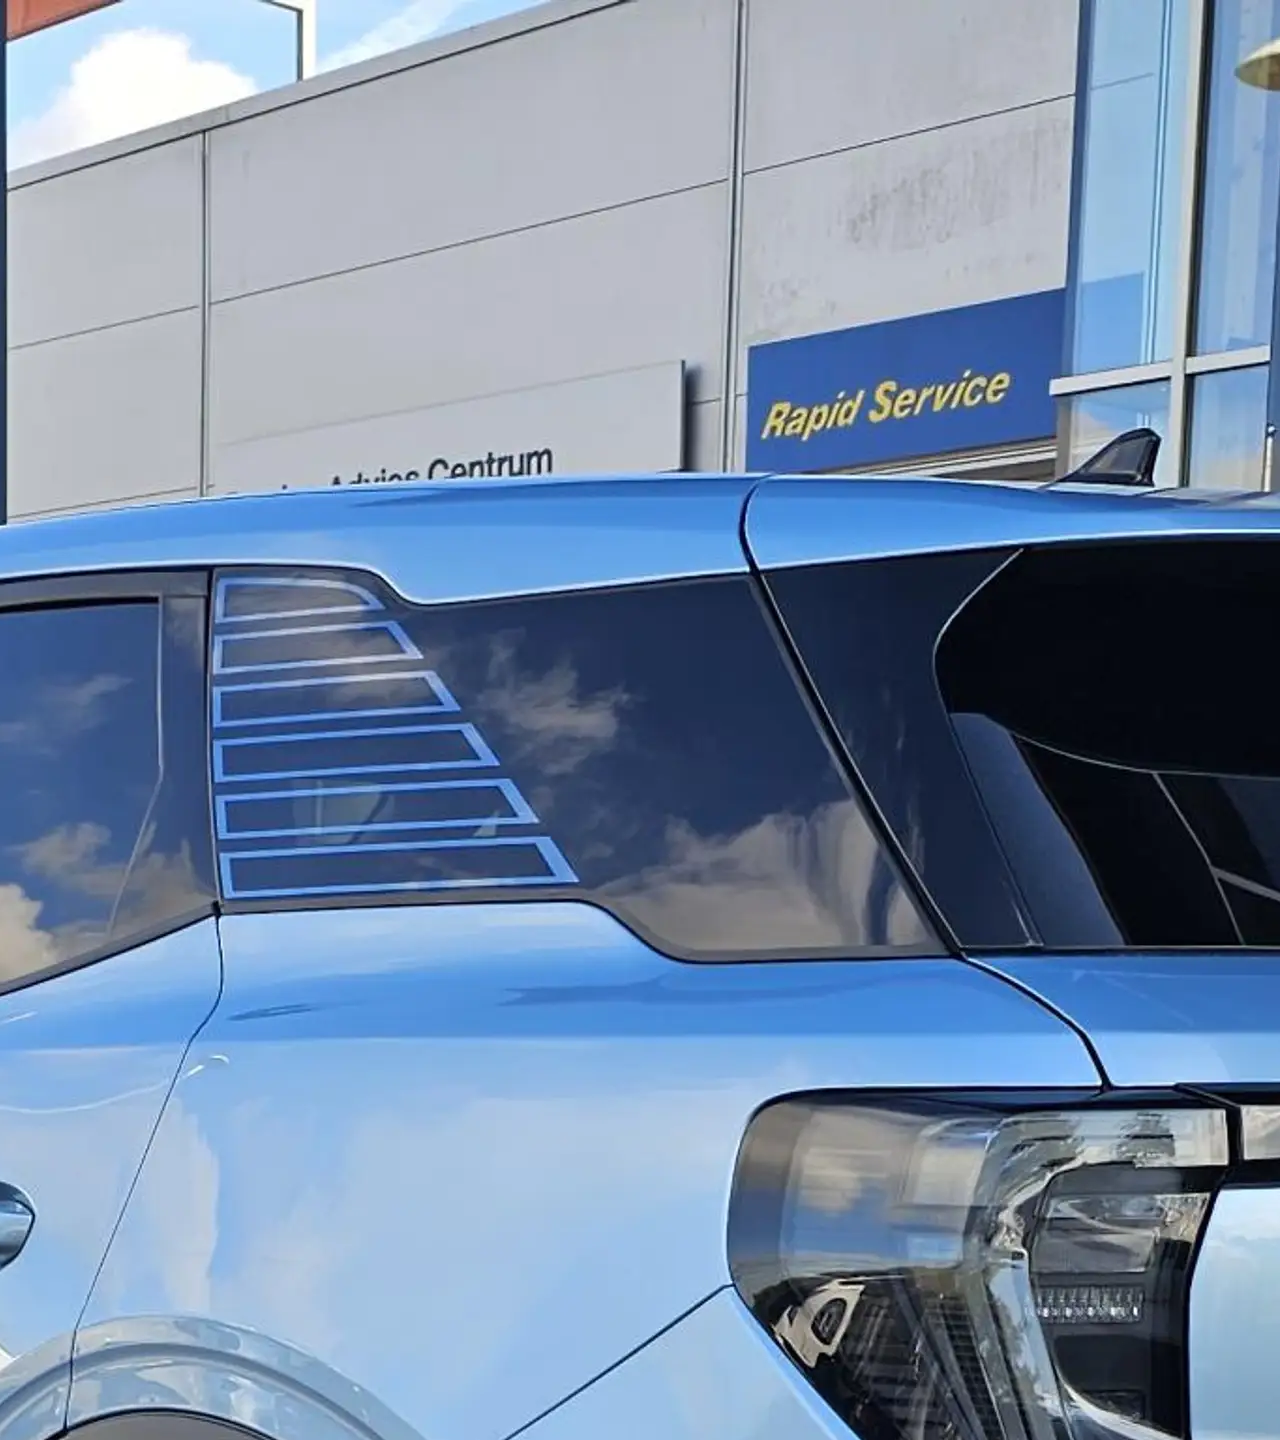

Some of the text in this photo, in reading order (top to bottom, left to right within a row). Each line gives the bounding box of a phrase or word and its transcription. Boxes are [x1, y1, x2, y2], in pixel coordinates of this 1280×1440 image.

[761, 369, 1011, 441] Rapid Service
[427, 448, 552, 480] Centrum
